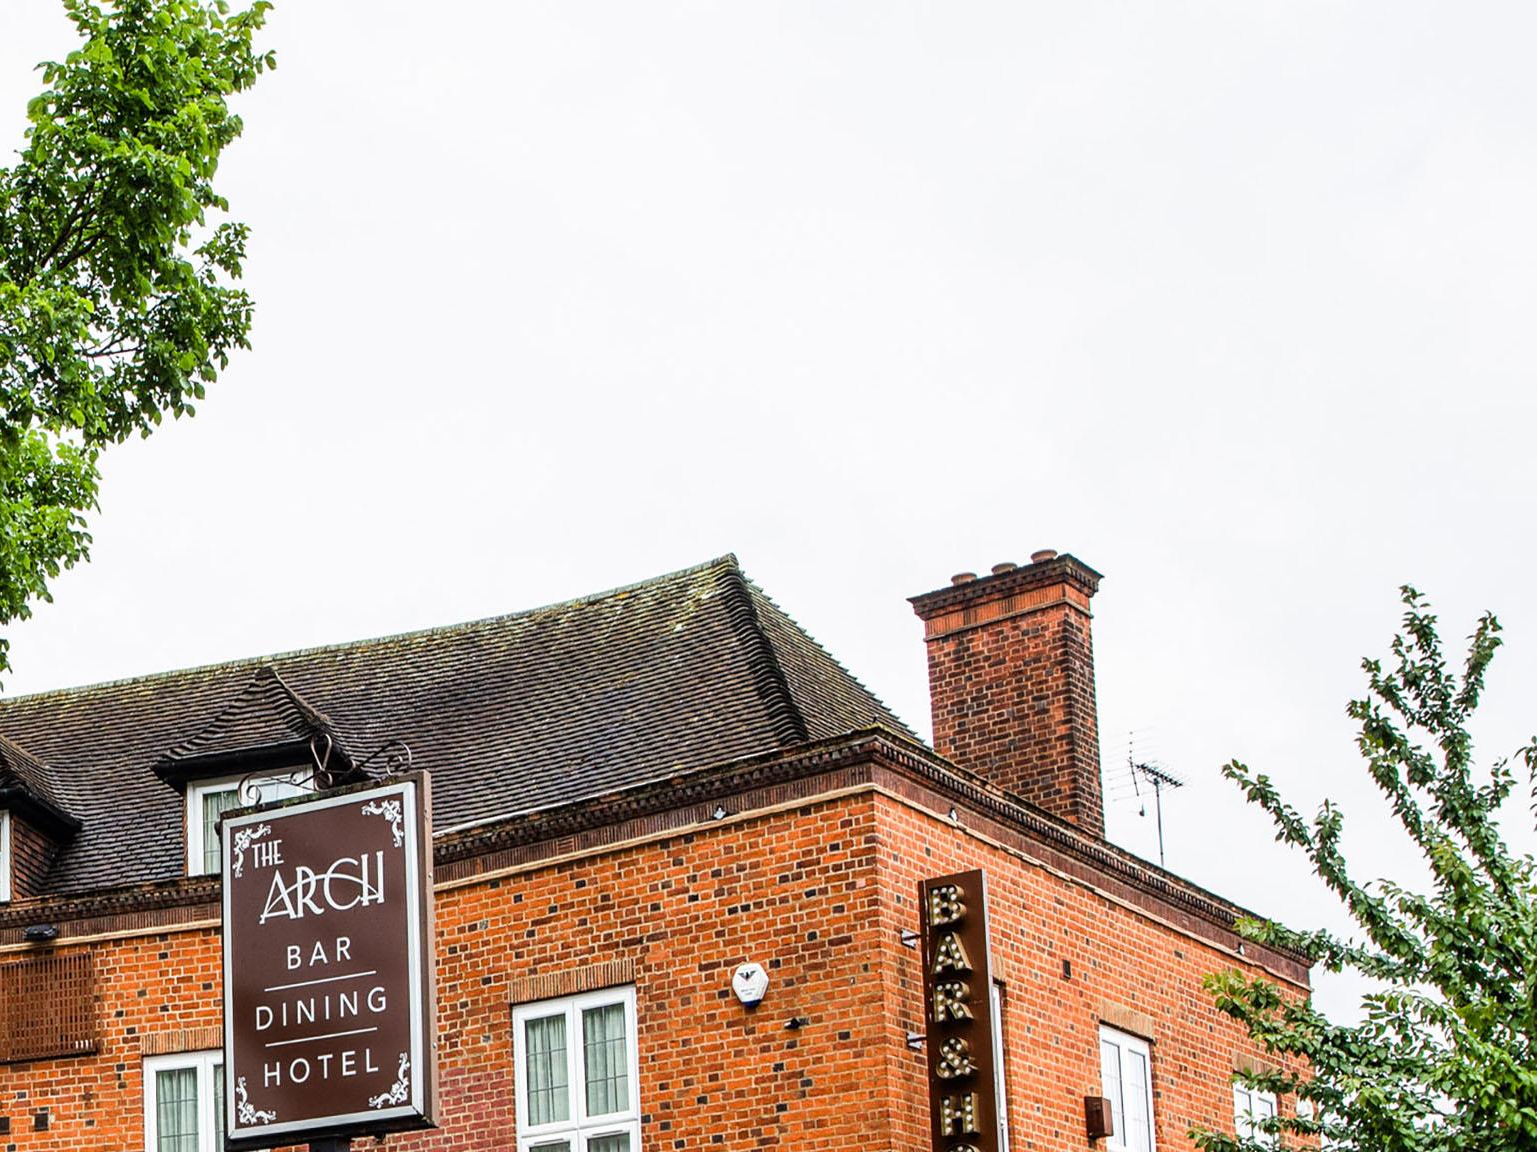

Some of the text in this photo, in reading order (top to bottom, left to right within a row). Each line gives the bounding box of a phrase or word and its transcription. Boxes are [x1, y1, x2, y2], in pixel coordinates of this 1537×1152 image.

[251, 839, 284, 869] THE
[259, 850, 385, 925] ARCH
[287, 937, 351, 970] BAR
[929, 884, 974, 1023] BAR
[255, 987, 387, 1031] DINING
[264, 1048, 380, 1088] HOTEL
[936, 1037, 978, 1081] &
